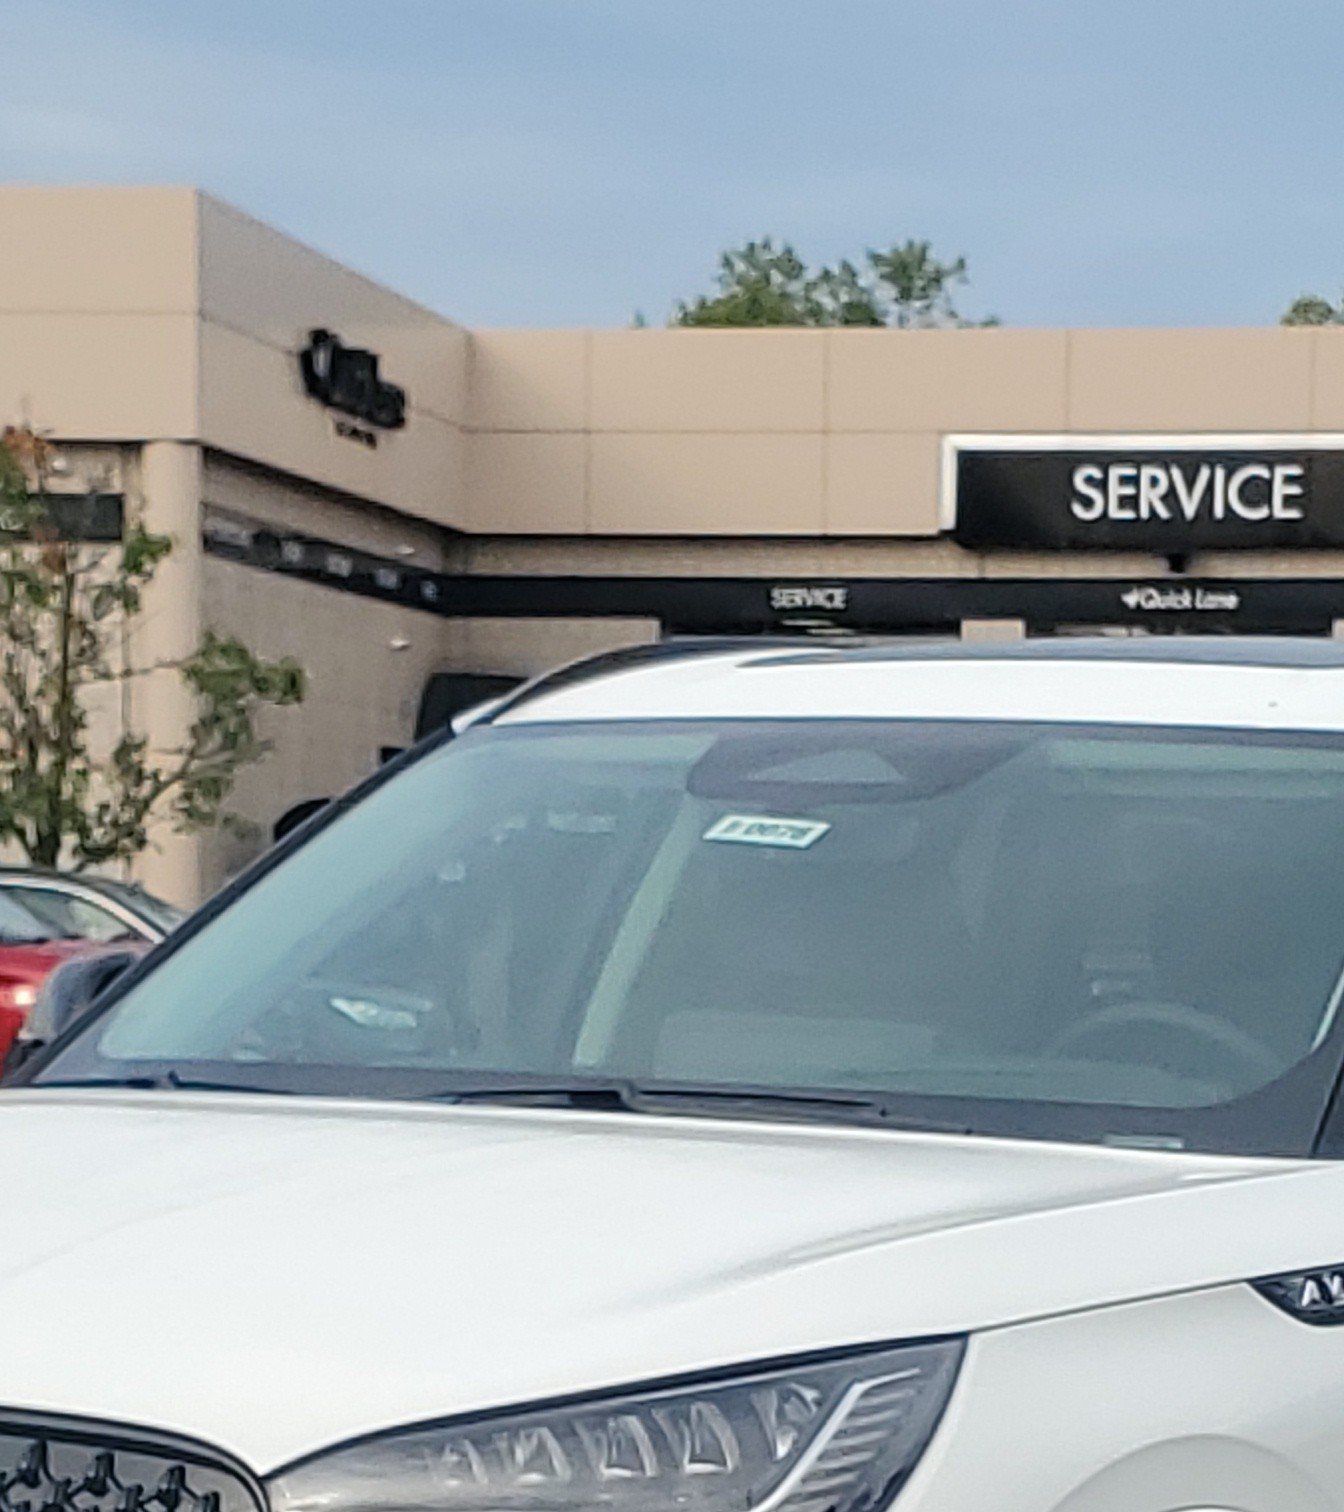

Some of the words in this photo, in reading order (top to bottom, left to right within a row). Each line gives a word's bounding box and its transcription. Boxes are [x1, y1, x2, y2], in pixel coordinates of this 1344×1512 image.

[1071, 464, 1305, 521] SERVICE
[770, 586, 848, 610] SERVICE
[1138, 587, 1193, 610] Quick
[1195, 587, 1239, 610] Lane
